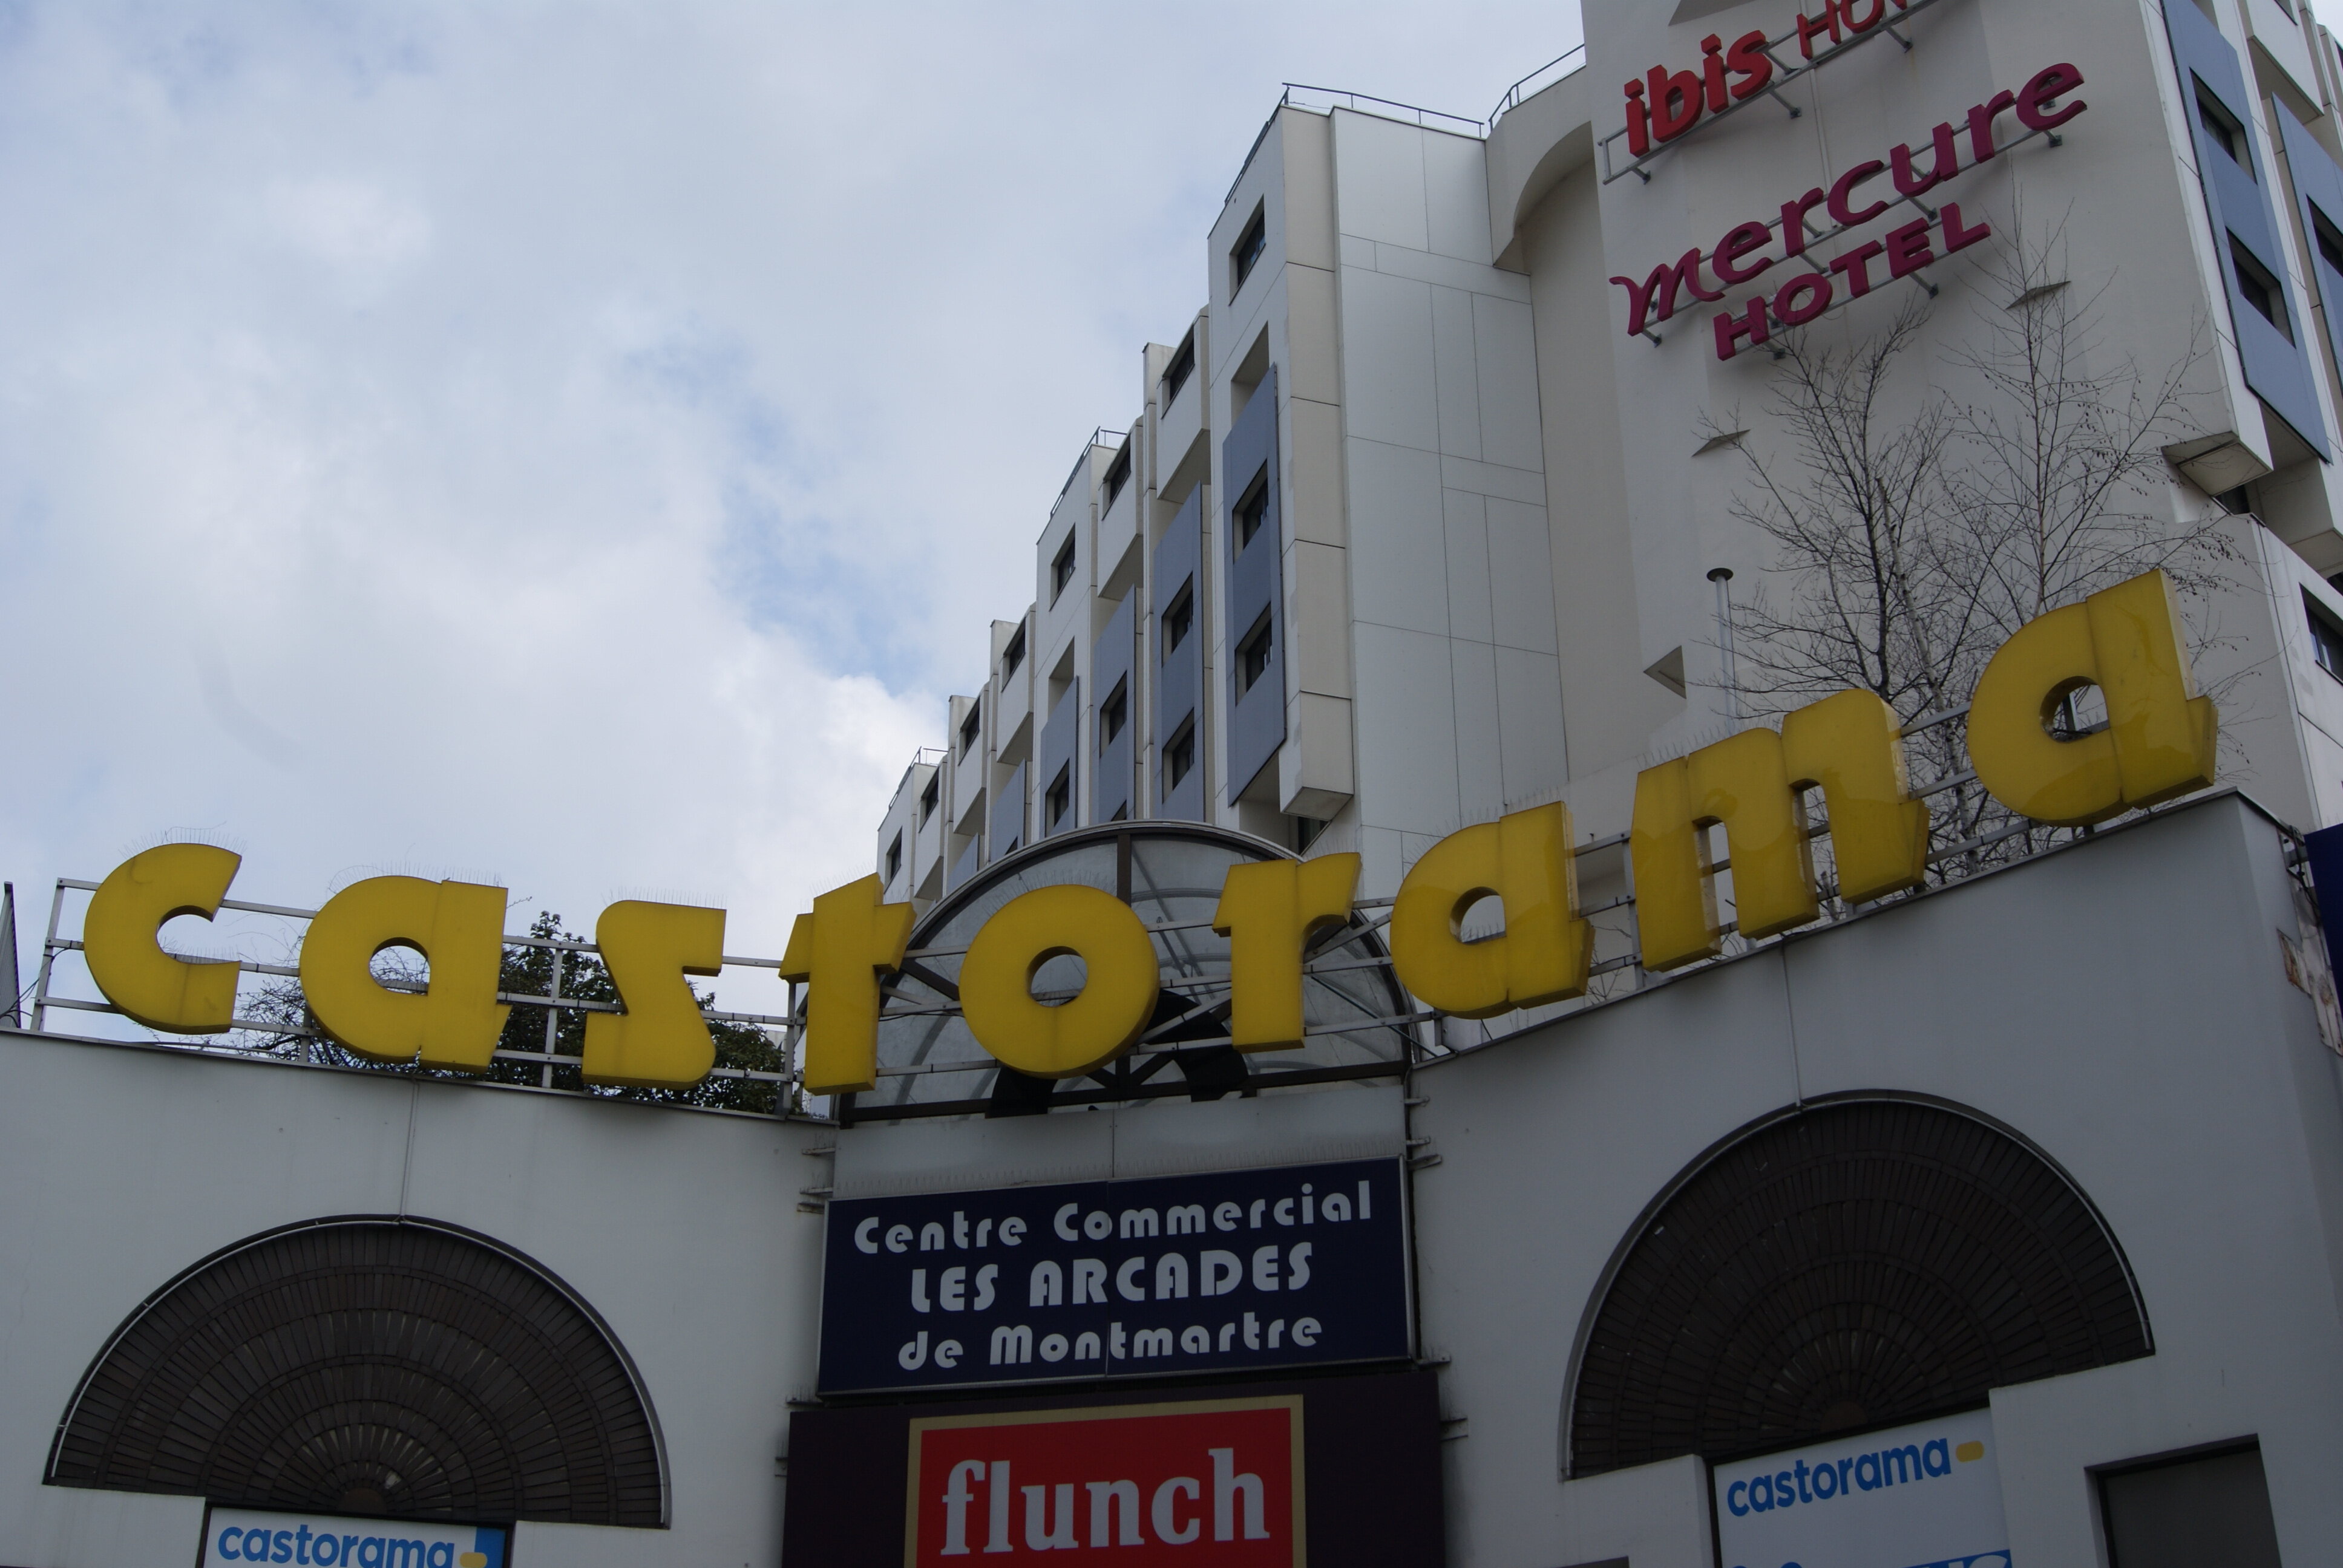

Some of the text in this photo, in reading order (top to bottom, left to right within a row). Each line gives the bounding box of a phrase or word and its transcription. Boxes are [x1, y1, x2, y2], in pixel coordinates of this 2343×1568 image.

[1624, 0, 1907, 158] ibis HO
[1609, 62, 2087, 336] mercure
[1713, 202, 1991, 361] HOTEL
[83, 569, 2219, 1095] castorama
[854, 1180, 1371, 1255] Centre Commercial
[911, 1241, 1312, 1313] LES ARCADES
[897, 1311, 1323, 1371] de Montmartre
[940, 1446, 1270, 1556] flunch
[1726, 1437, 1951, 1517] castorama
[218, 1524, 454, 1568] castorama
